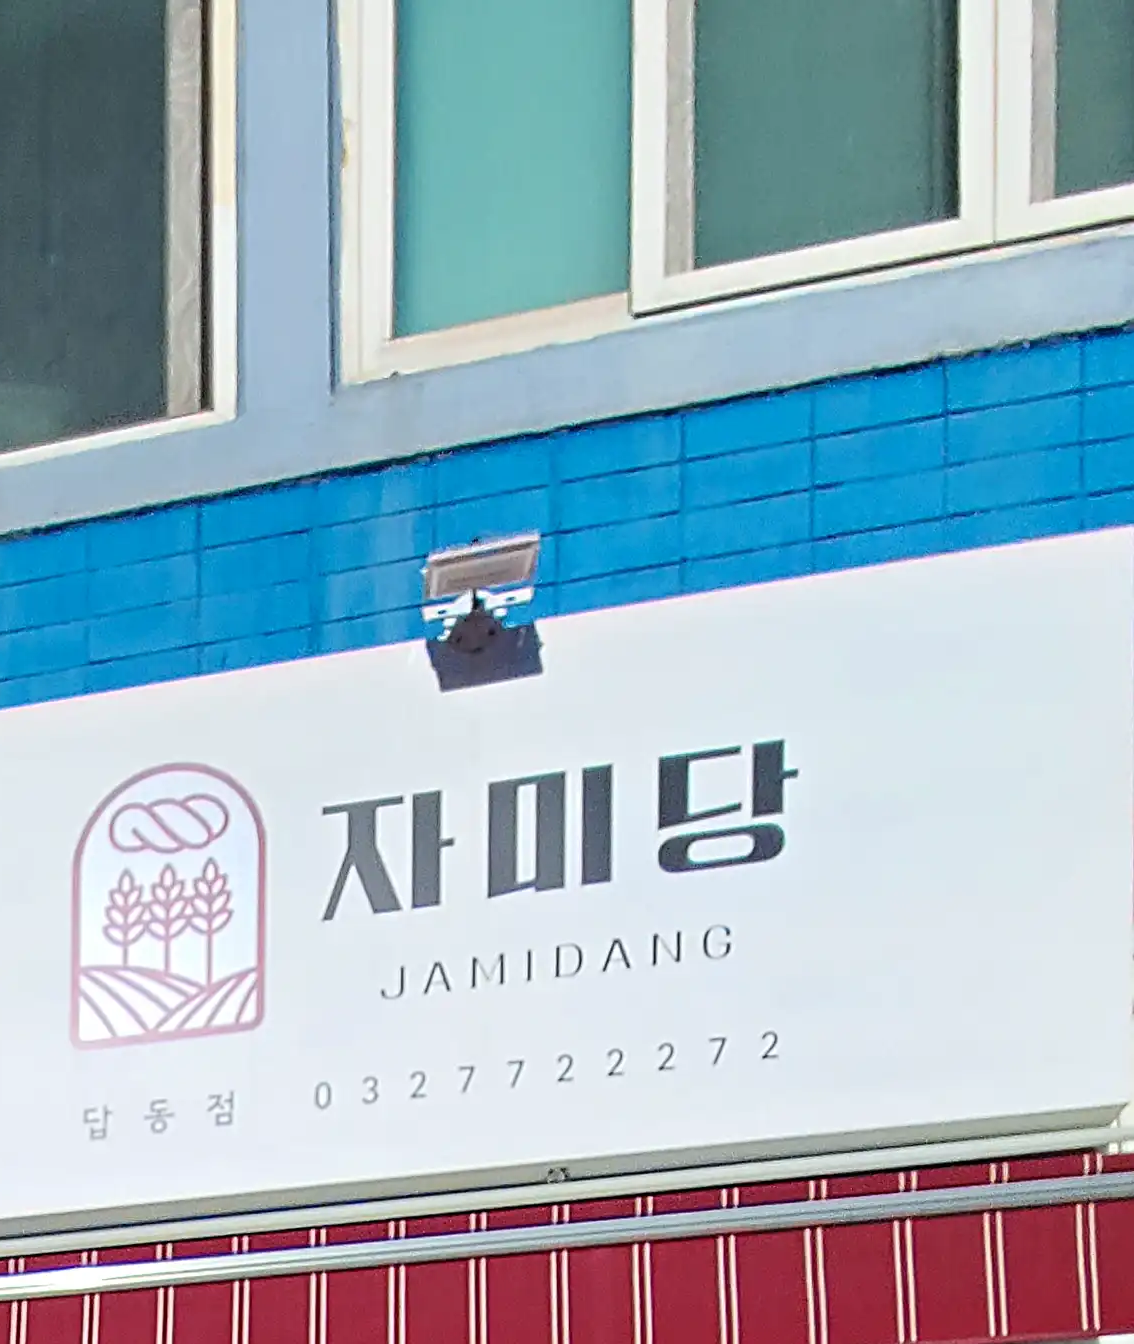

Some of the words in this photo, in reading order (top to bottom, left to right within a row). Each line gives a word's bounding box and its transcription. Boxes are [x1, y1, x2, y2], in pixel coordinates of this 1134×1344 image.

[321, 738, 799, 922] 자미당
[380, 924, 735, 1000] JAMIDANG
[83, 1090, 236, 1141] 답동점
